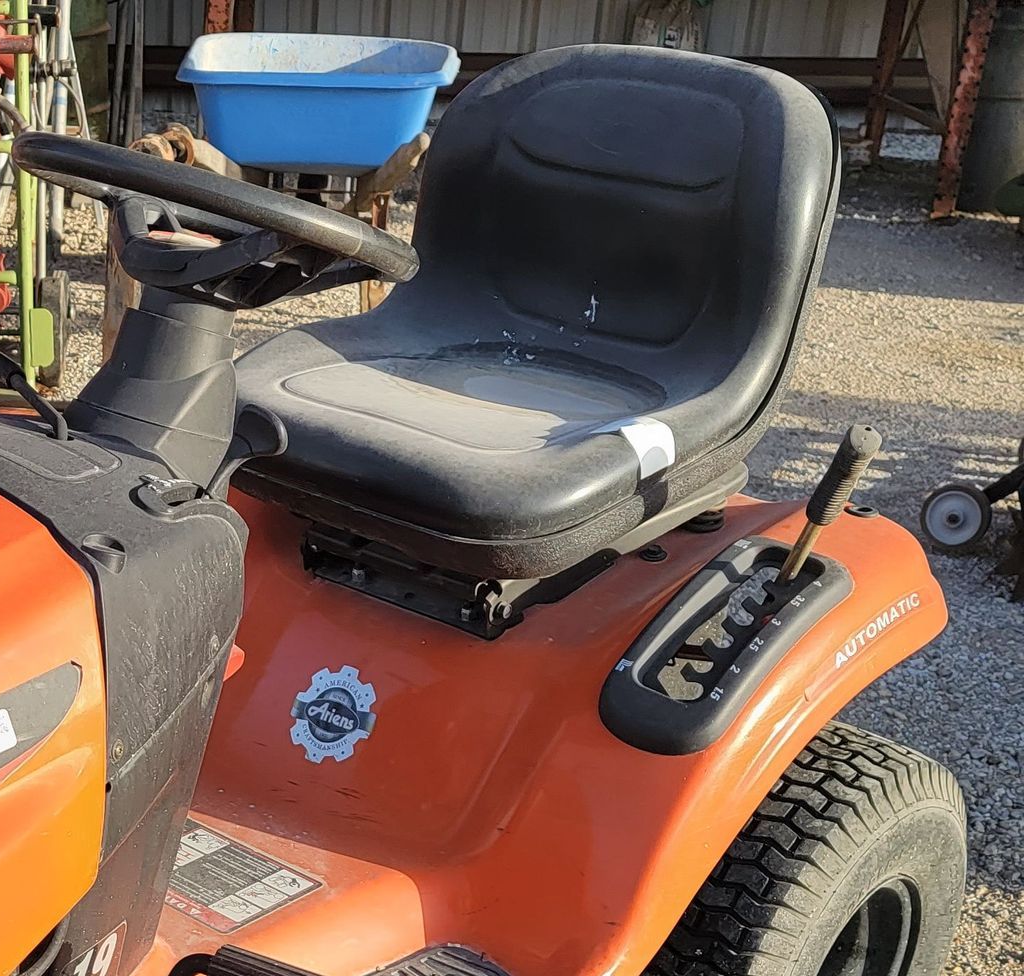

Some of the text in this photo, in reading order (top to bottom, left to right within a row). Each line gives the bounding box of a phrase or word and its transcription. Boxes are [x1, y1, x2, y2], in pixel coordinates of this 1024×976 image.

[771, 618, 782, 626] 3
[835, 592, 920, 669] AUTOMATIC
[749, 637, 764, 652] 2.5
[730, 665, 741, 674] 2
[324, 680, 363, 700] AMERICAN
[307, 702, 355, 730] Ariens
